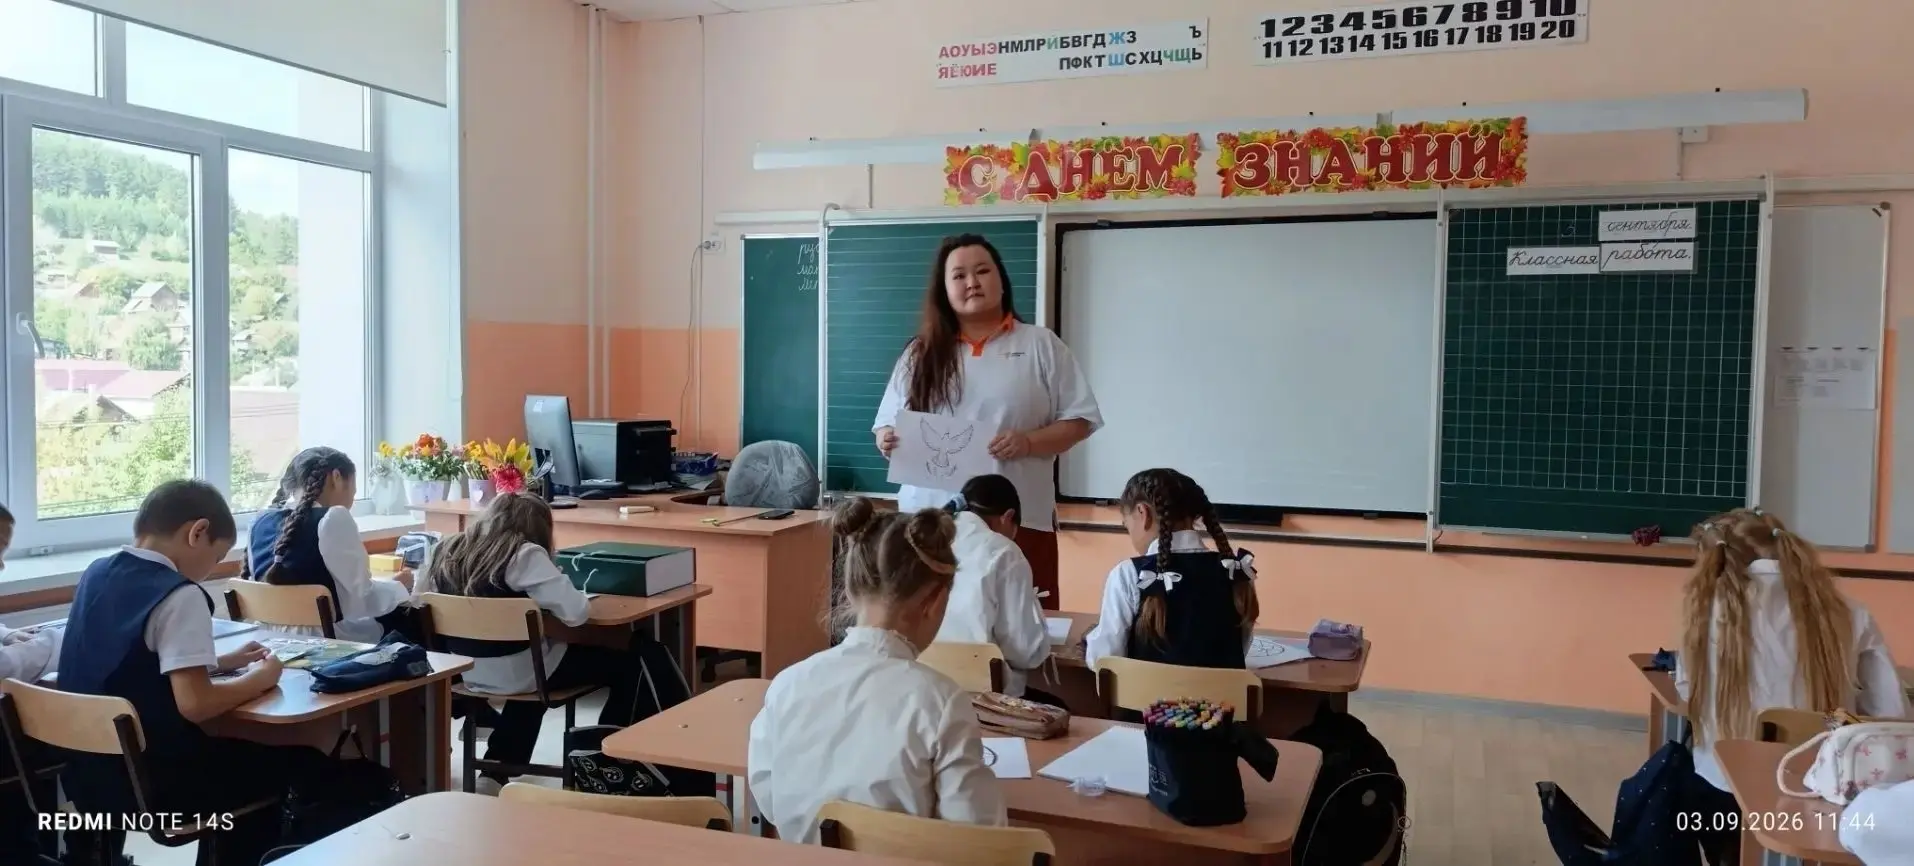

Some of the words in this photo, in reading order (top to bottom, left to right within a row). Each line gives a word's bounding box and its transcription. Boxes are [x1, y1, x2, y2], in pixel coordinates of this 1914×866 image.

[1260, 19, 1276, 38] 1
[1282, 16, 1305, 36] 2
[1311, 14, 1334, 34] 3
[1339, 11, 1367, 31] 4
[1372, 9, 1396, 29] 5
[1402, 6, 1428, 27] 6
[1433, 4, 1455, 25] 7
[1462, 1, 1488, 23] 8
[1496, 0, 1522, 20] 9
[1530, 0, 1576, 18] 10
[1263, 41, 1282, 58] 11
[1288, 38, 1313, 56] 12
[1319, 36, 1344, 54] 13
[1348, 34, 1375, 52] 14
[1381, 32, 1407, 50] 15
[1413, 29, 1439, 48] 16
[1444, 27, 1469, 46] 17
[1475, 24, 1502, 44] 18
[1508, 22, 1535, 41] 19
[1540, 19, 1575, 40] 20
[957, 146, 996, 196] С
[1233, 122, 1506, 190] ЗНАНИЙ
[1509, 250, 1599, 267] Классная
